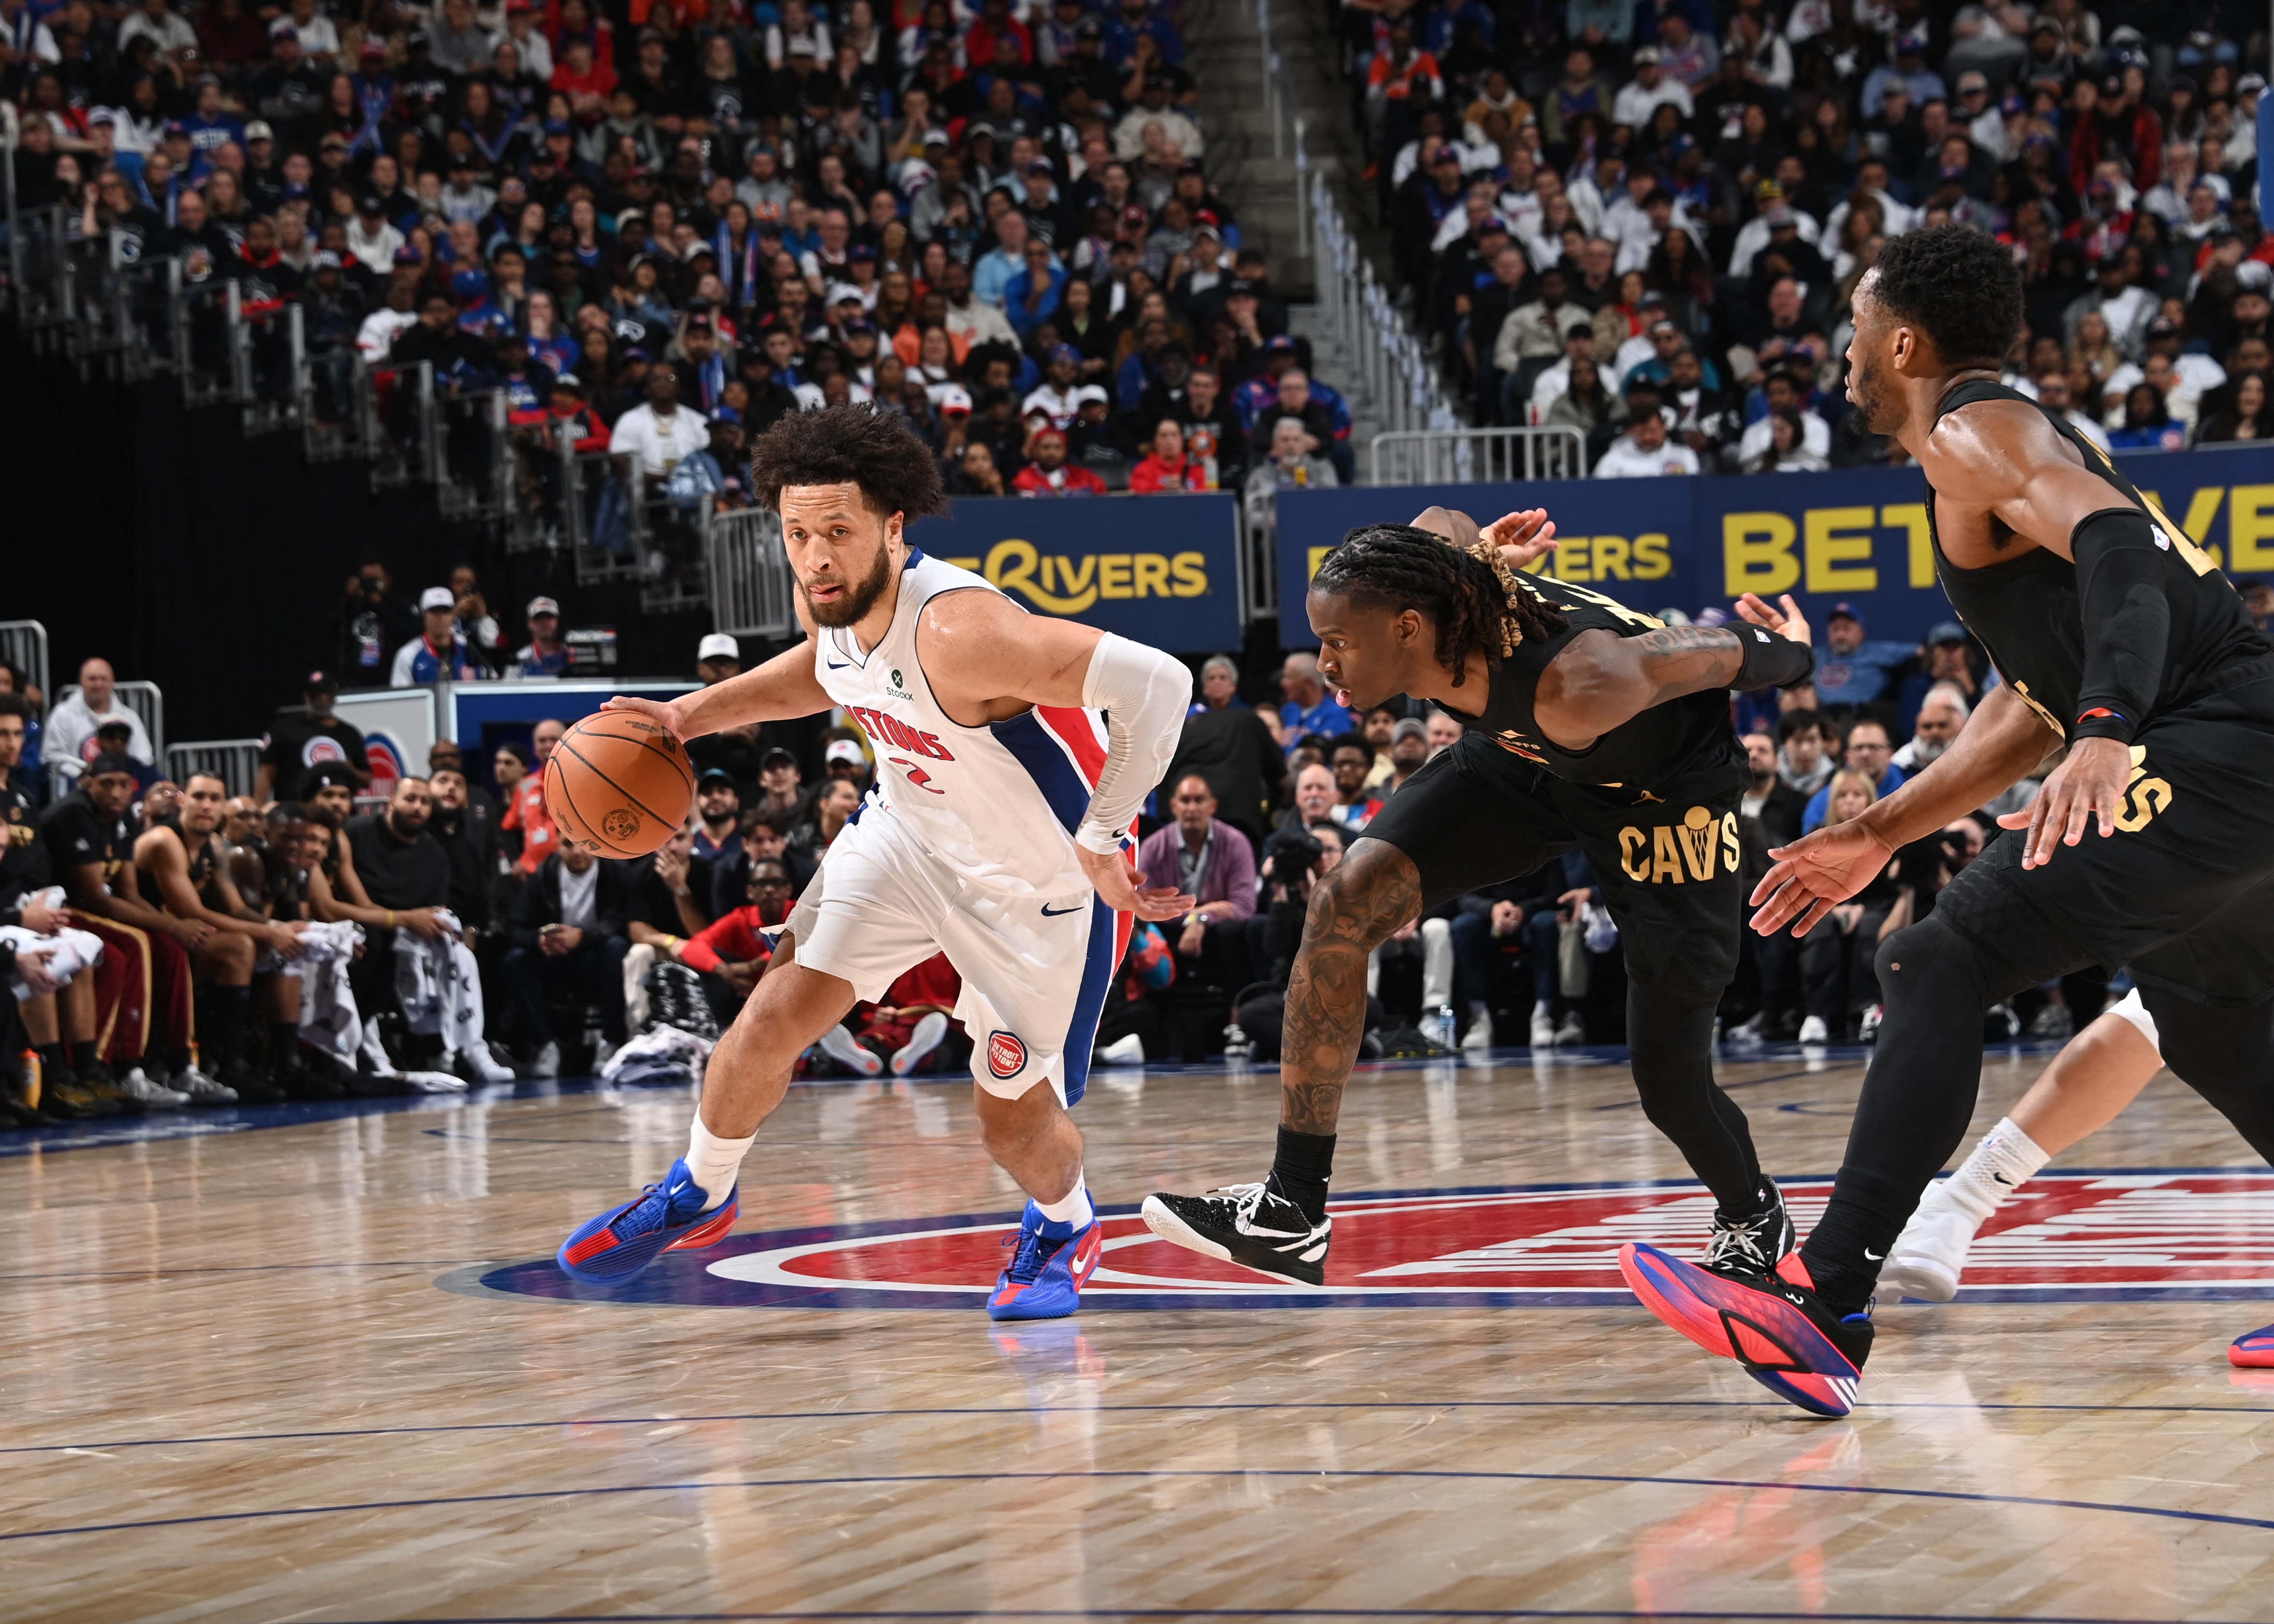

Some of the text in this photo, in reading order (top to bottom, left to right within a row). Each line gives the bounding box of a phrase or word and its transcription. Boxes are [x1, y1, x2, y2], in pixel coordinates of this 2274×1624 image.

[886, 687, 914, 702] StockX
[841, 705, 955, 762] ISTONS
[1497, 737, 1541, 750] CLIFFS
[889, 757, 945, 794] 2
[1618, 805, 1740, 884] CAVS
[991, 1045, 1017, 1069] PISTONS
[993, 1039, 1019, 1061] DETROIT
